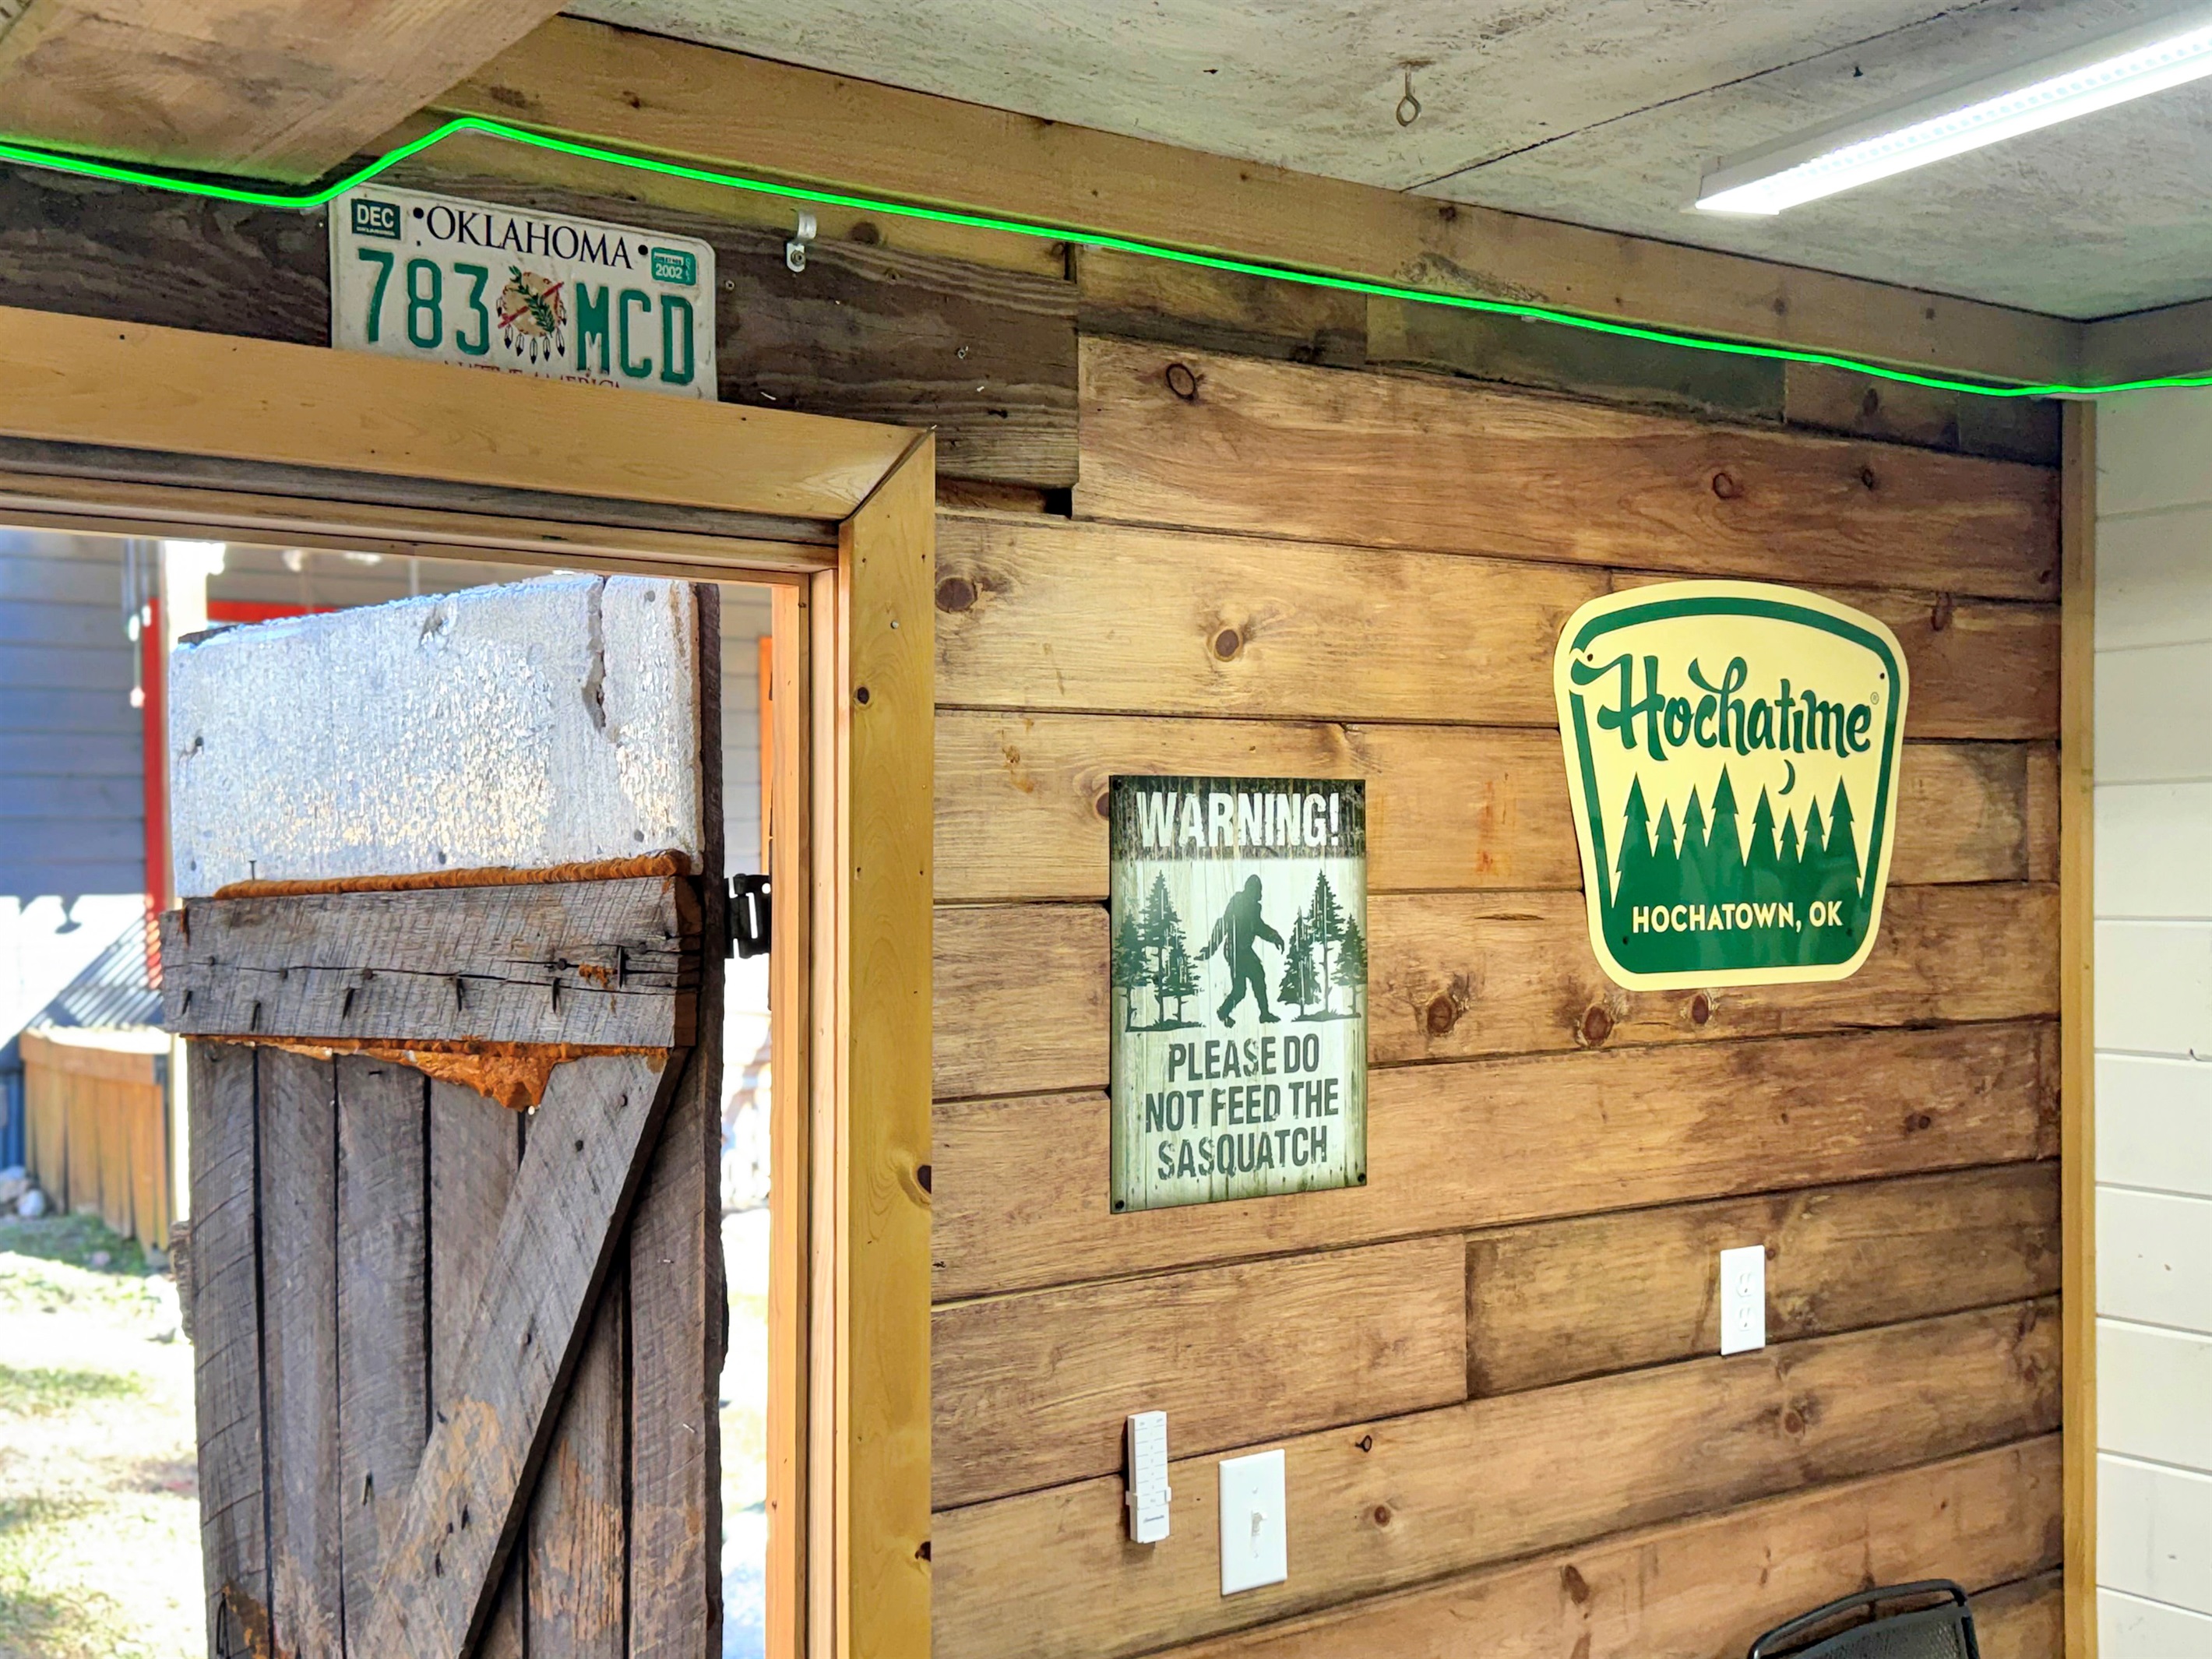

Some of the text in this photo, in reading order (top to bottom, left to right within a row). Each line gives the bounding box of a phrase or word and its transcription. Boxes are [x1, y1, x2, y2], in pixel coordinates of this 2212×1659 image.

[357, 203, 394, 228] DEC
[427, 206, 633, 269] OKLAHOMA
[655, 262, 683, 280] 2002
[358, 248, 695, 386] 783 MCD
[1136, 791, 1340, 847] WARNING!
[1633, 900, 1843, 934] HOCHATOWN, OK
[1168, 1033, 1320, 1083] PLEASE DO
[1146, 1078, 1339, 1133] NOT FEED THE
[1157, 1125, 1328, 1181] SASQUATCH
